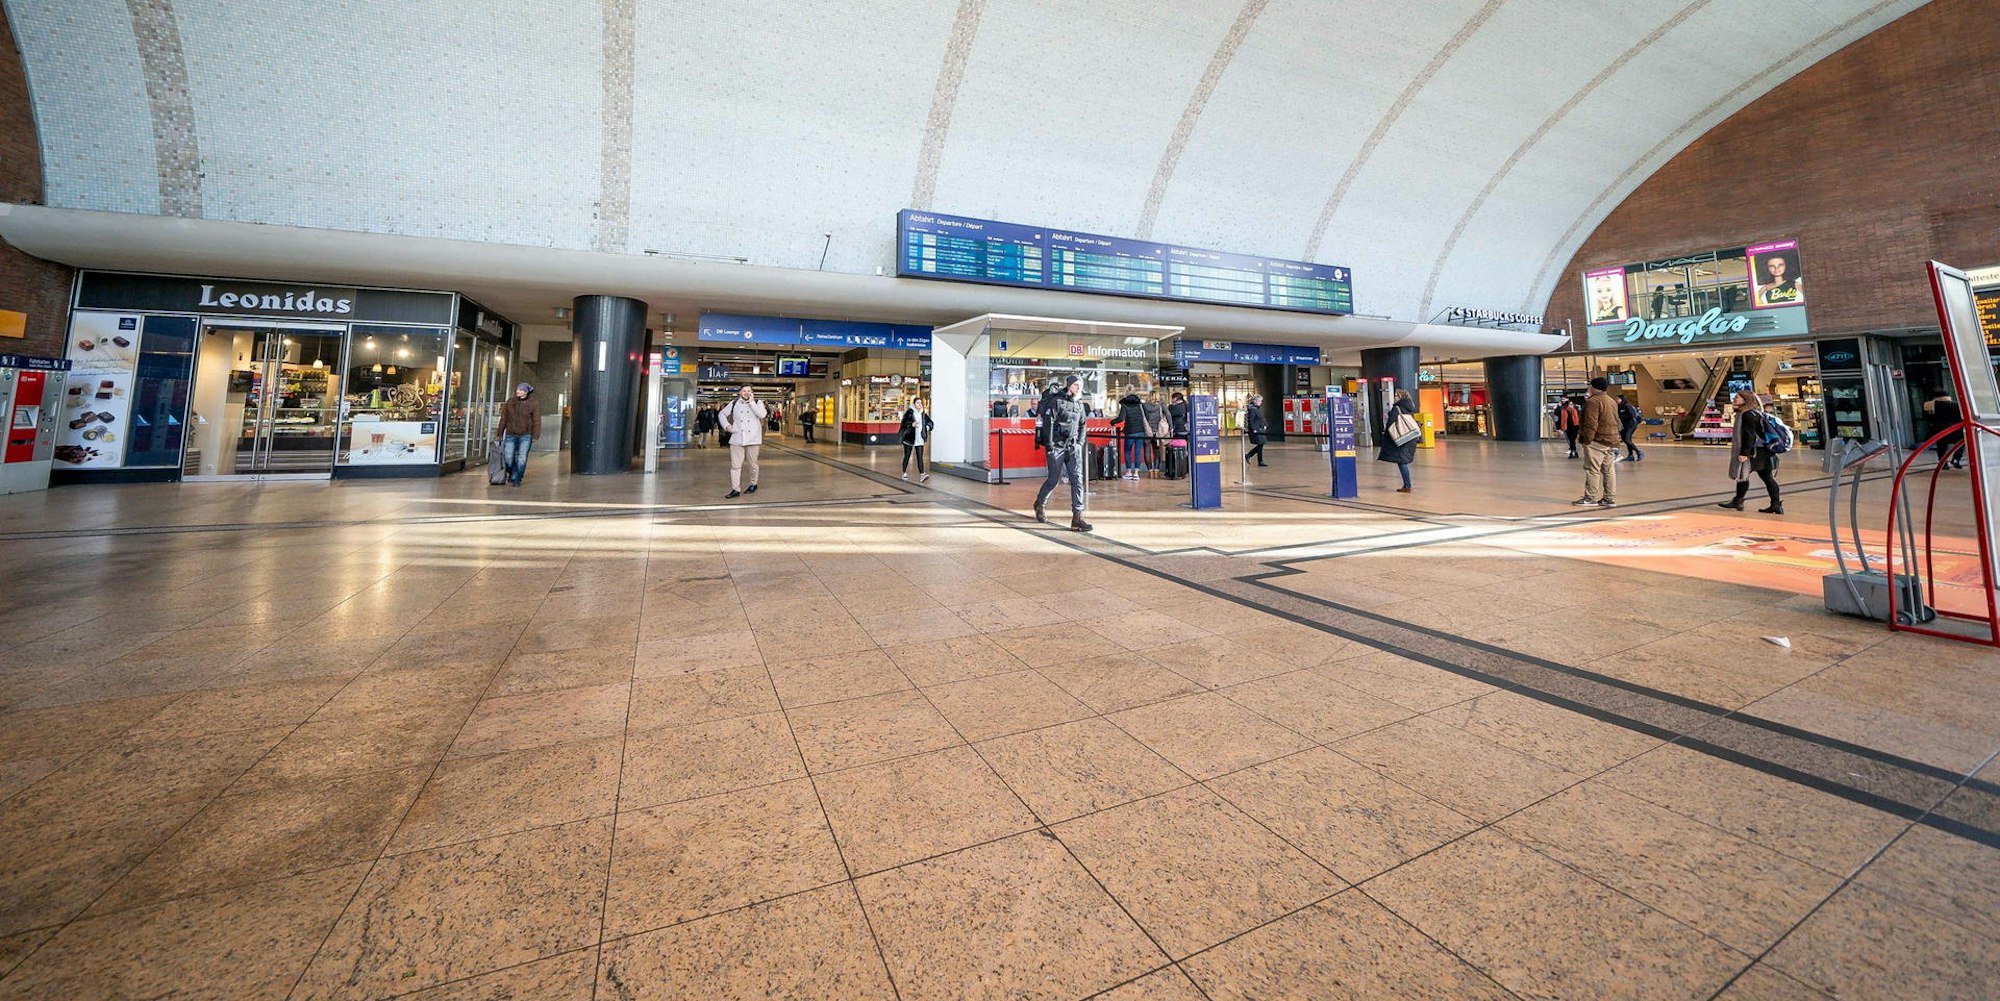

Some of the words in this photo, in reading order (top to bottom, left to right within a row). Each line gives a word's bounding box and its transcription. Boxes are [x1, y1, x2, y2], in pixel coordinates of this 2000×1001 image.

[910, 214, 934, 224] Abfahrt
[937, 218, 962, 228] Departure
[1052, 233, 1073, 241] Abfahrt
[199, 284, 351, 314] Leonidas
[1466, 308, 1515, 321] STARBUCKS
[1515, 313, 1544, 325] COFFEE
[1623, 307, 1750, 344] Douglas
[1071, 346, 1083, 355] DB
[1088, 345, 1146, 358] Information
[904, 376, 919, 384] Stop
